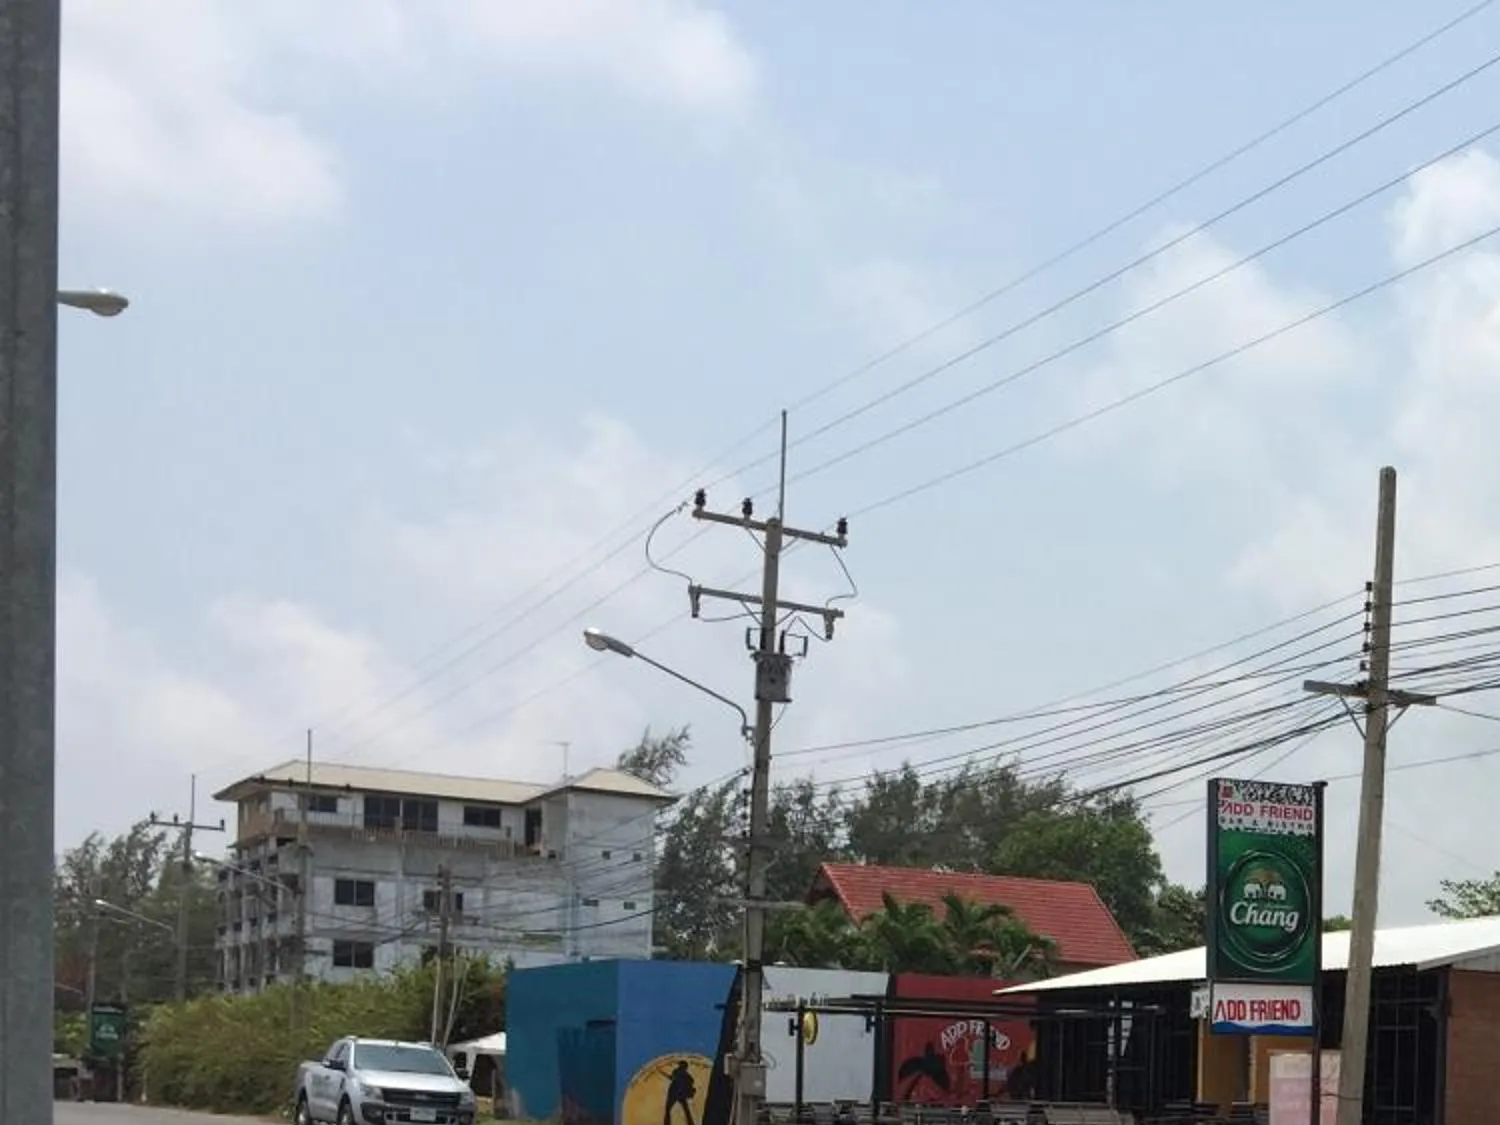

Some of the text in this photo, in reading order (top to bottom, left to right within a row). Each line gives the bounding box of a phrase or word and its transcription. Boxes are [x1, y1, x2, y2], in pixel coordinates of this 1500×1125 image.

[1222, 802, 1313, 821] ADD FRIEND
[1230, 901, 1299, 933] Chang
[1215, 999, 1301, 1021] ADD FRIEND
